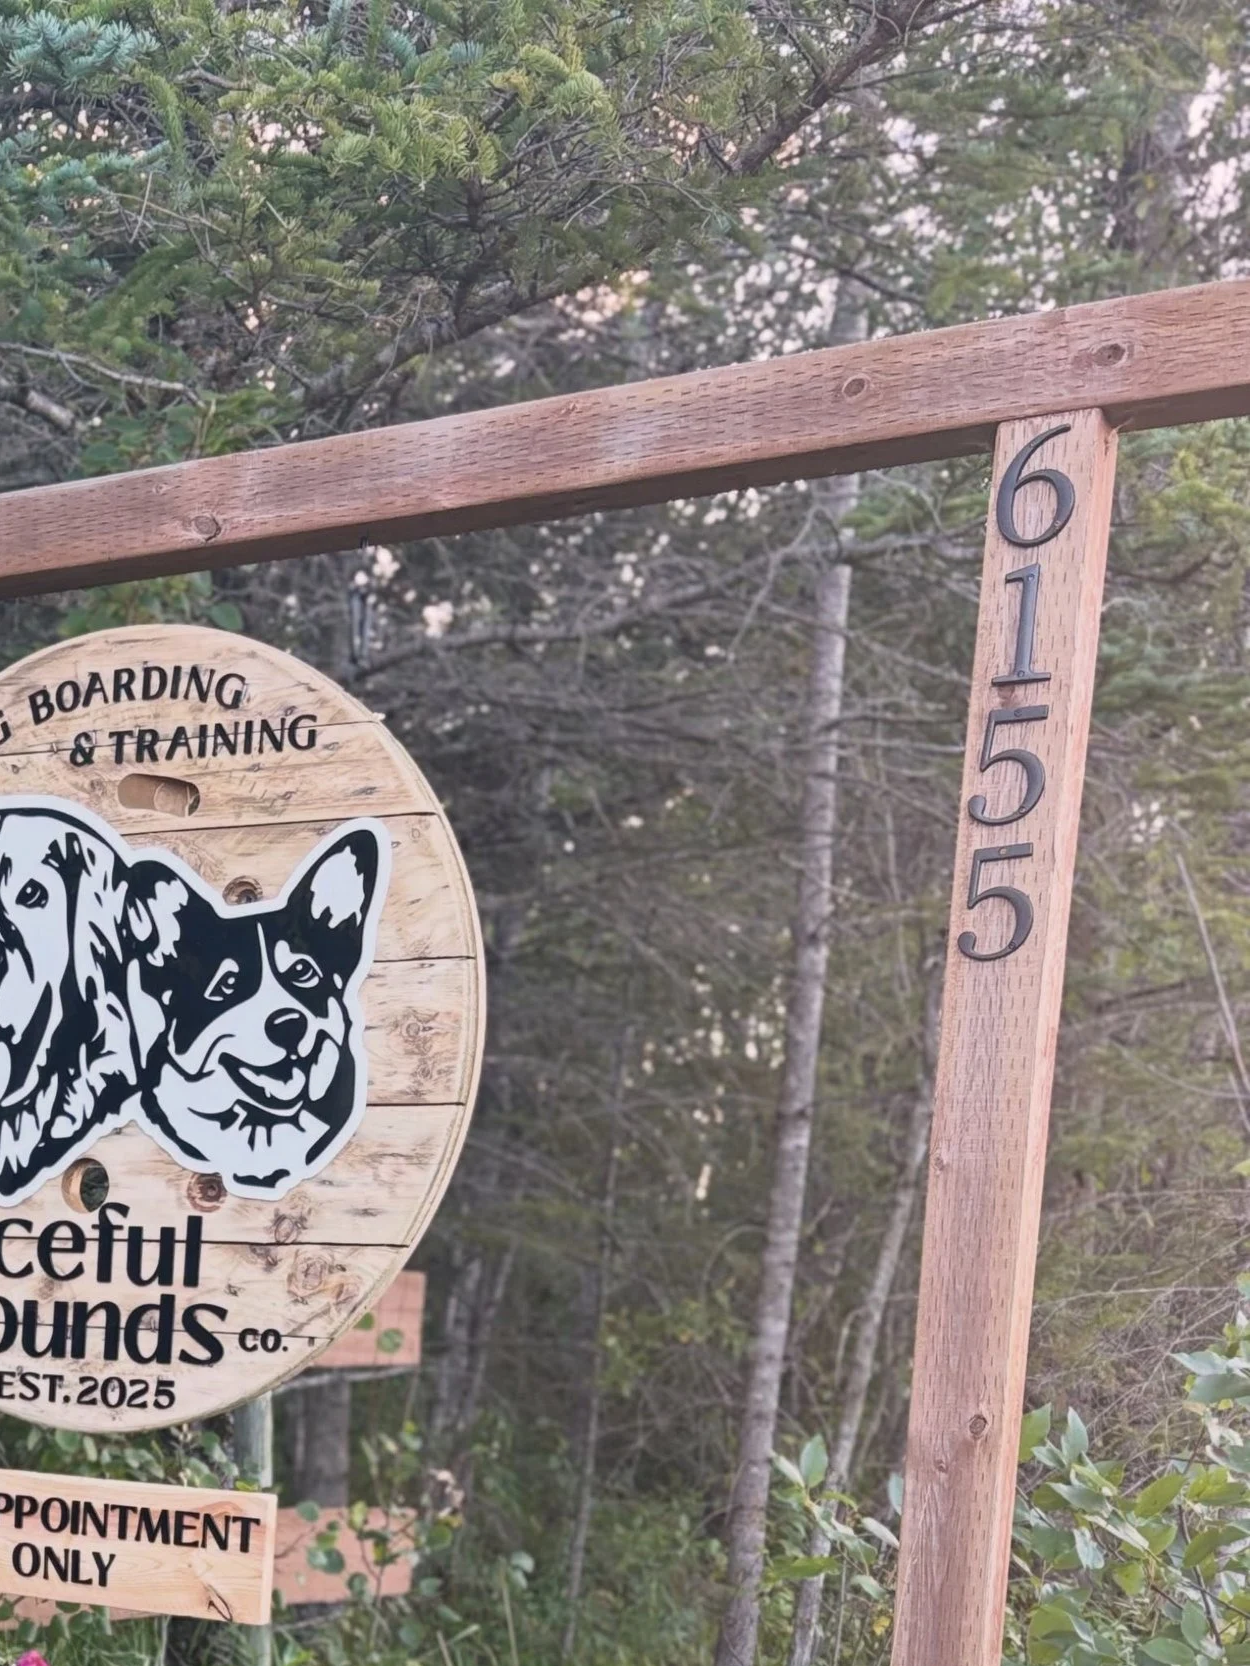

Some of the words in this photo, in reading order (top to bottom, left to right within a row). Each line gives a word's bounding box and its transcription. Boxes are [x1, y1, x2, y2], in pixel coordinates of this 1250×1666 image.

[28, 664, 247, 726] BOARDING
[957, 423, 1076, 962] 61555
[69, 732, 96, 767] &
[108, 713, 319, 765] TRAINING
[12, 1542, 116, 1587] ONLY
